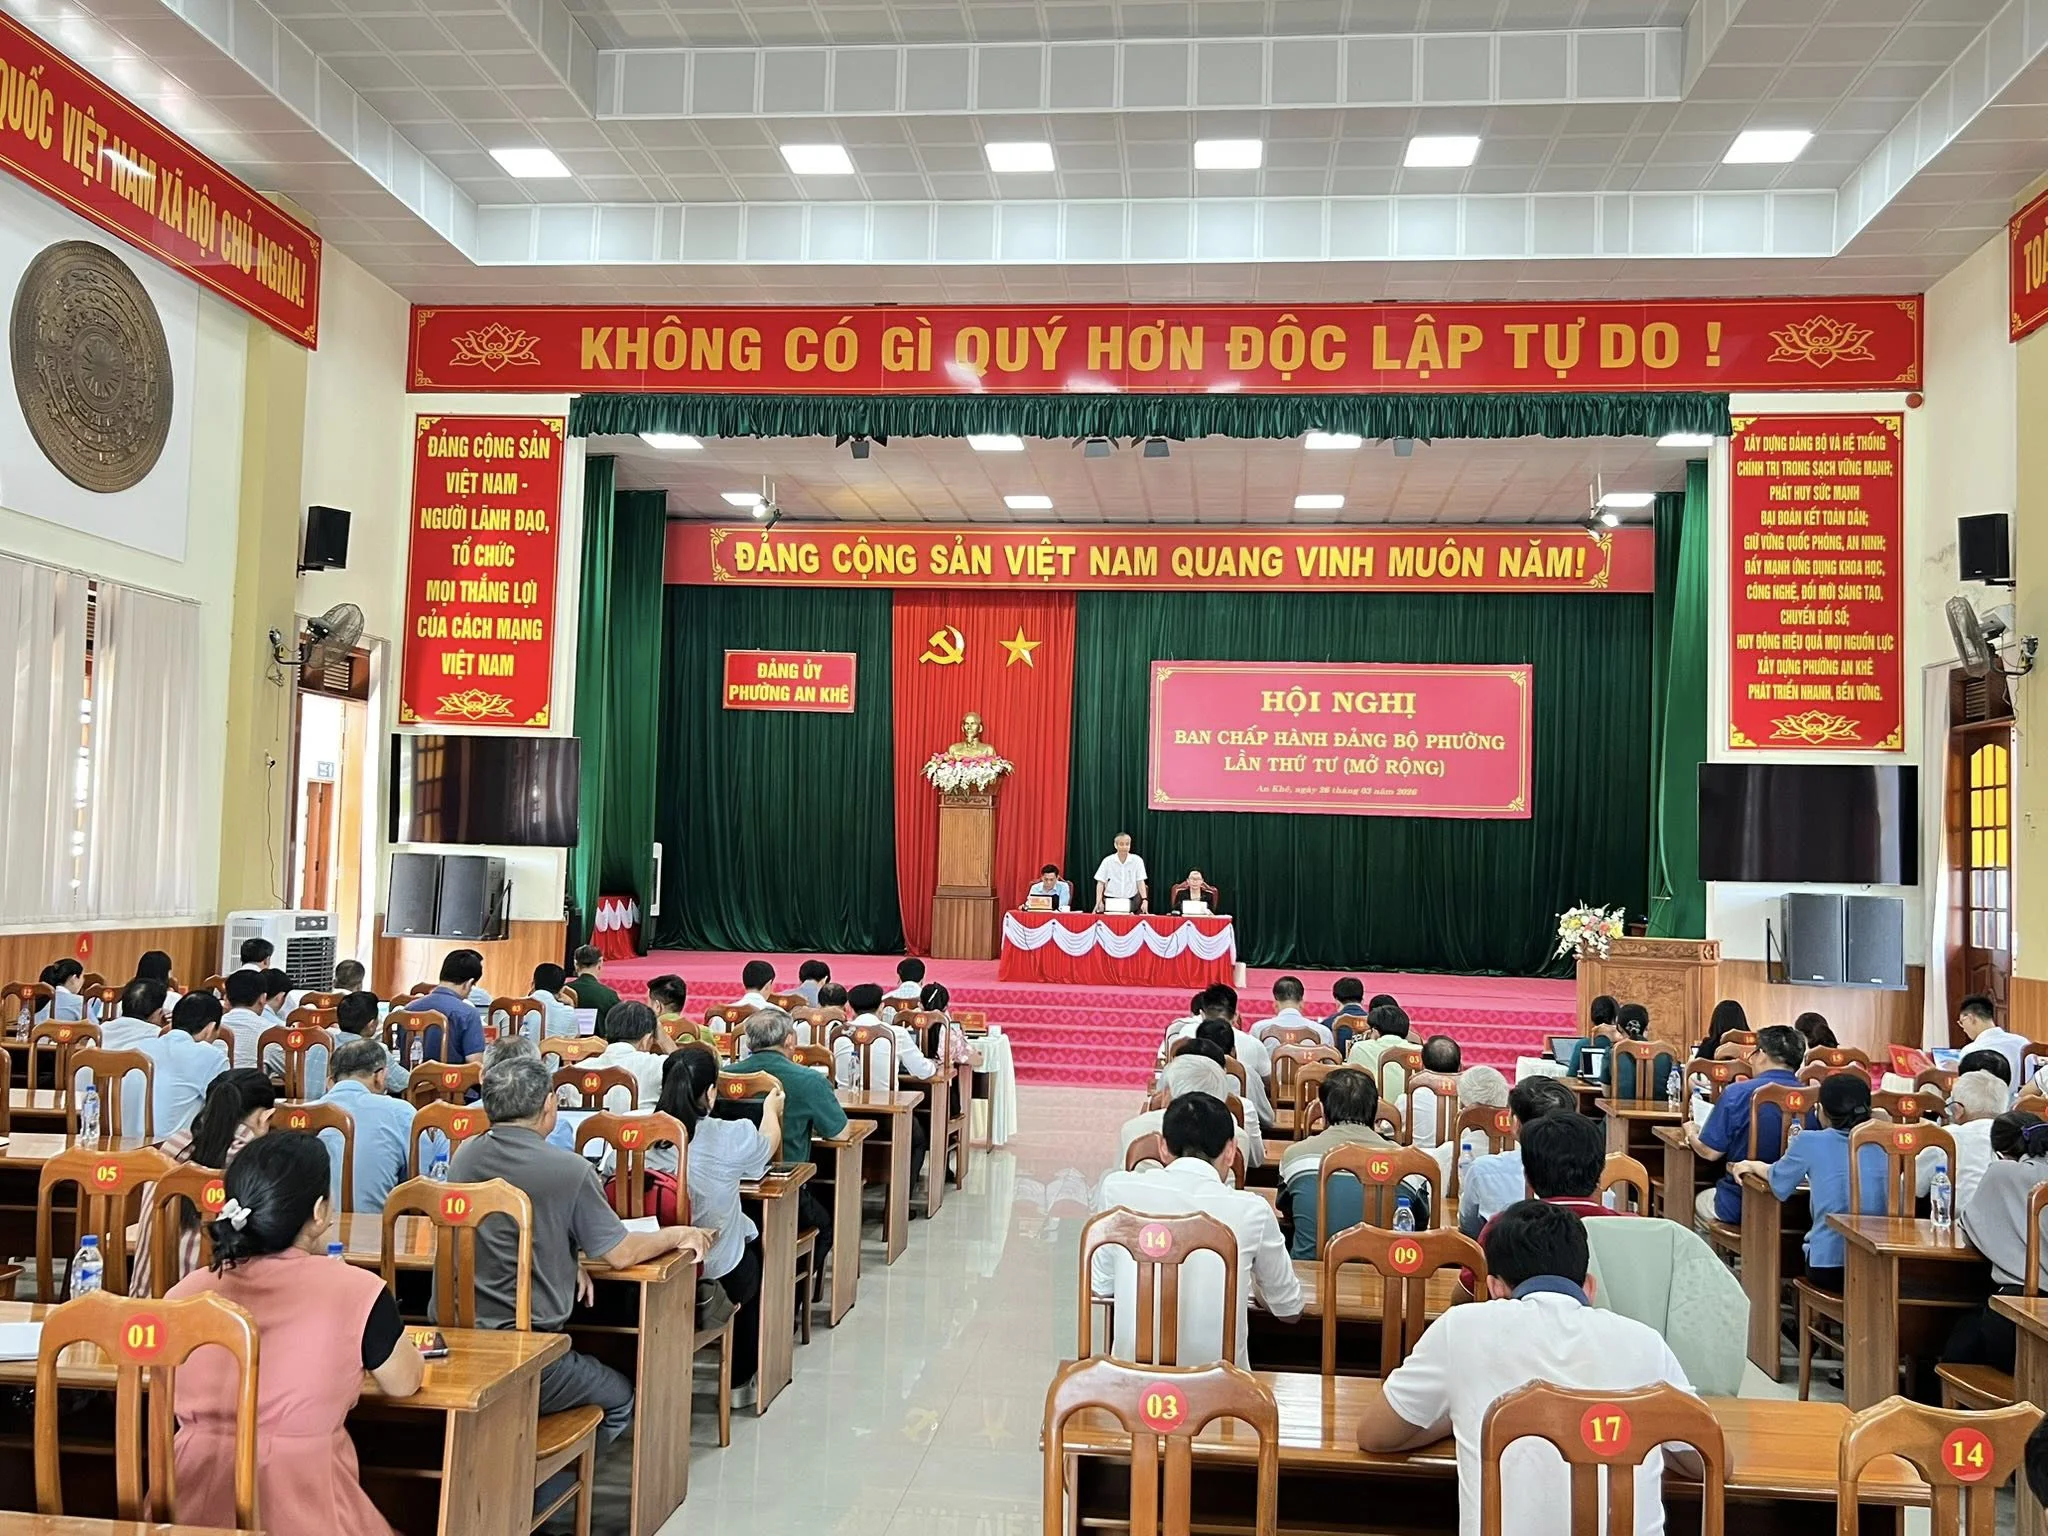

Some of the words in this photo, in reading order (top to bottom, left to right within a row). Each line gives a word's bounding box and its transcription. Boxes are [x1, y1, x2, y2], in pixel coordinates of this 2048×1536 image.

[62, 102, 107, 186] VIỆT
[111, 134, 156, 216] NAM
[159, 168, 183, 233] XÃ
[187, 184, 216, 258] HỘI
[221, 209, 252, 275] CHỦ
[256, 233, 305, 309] NGHĨA!
[581, 315, 761, 371] KHÔNG
[785, 316, 856, 372] CÓ
[882, 317, 931, 372] GÌ
[955, 315, 1066, 378] QUÝ
[1087, 318, 1206, 372] HƠN
[1223, 314, 1346, 384] ĐỘC
[1373, 314, 1483, 379] LẬP
[1504, 317, 1585, 378] TỰ
[1600, 322, 1679, 368] DO
[1707, 322, 1721, 366] !
[428, 428, 468, 457] ĐẢNG
[473, 432, 514, 462] CỘNG
[519, 430, 550, 459] SẢN
[447, 468, 478, 498] VIỆT
[482, 473, 517, 494] NAM
[421, 504, 467, 529] NGƯỜI
[471, 505, 510, 530] LÃNH
[515, 509, 549, 535] ĐẠO,
[452, 536, 472, 566] TỔ
[474, 541, 515, 567] CHỨC
[735, 533, 819, 573] ĐẢNG
[832, 536, 916, 579] CỘNG
[930, 535, 991, 574] SẢN
[1004, 537, 1075, 581] VIỆT
[1091, 546, 1157, 575] NAM
[1172, 546, 1283, 578] QUANG
[1296, 546, 1373, 576] VINH
[1389, 538, 1484, 577] MUÔN
[1499, 539, 1585, 577] NĂM!
[426, 580, 455, 606] MỌI
[460, 573, 509, 603] THẮNG
[514, 580, 537, 608] LỢI
[418, 608, 447, 638] CỦA
[452, 612, 492, 639] CÁCH
[497, 618, 542, 644] MẠNG
[442, 649, 475, 679] VIỆT
[478, 654, 514, 676] NAM
[758, 658, 799, 679] ĐẢNG
[729, 682, 790, 701] PHƯỜNG
[794, 686, 816, 702] AN
[820, 685, 849, 703] KHÊ
[1261, 686, 1320, 717] HỘI
[1332, 692, 1416, 719] NGHỊ
[1175, 730, 1211, 744] BAN
[1217, 725, 1268, 745] CHẤP
[1274, 728, 1328, 746] HÀNH
[1334, 728, 1387, 748] ĐẢNG
[1393, 730, 1418, 751] BỘ
[1426, 731, 1505, 750] PHƯỜNG
[1224, 749, 1261, 771] LẦN
[1268, 754, 1307, 772] THỨ
[1313, 756, 1338, 772] TƯ
[1344, 754, 1379, 775] (MỞ
[1385, 757, 1444, 777] RỘNG)
[79, 939, 89, 953] A
[290, 1034, 302, 1045] 14
[1408, 1054, 1421, 1064] 03
[1638, 1046, 1650, 1056] 14
[445, 1072, 458, 1084] 07
[584, 1076, 598, 1087] 04
[729, 1082, 743, 1094] 08
[1788, 1095, 1802, 1108] 14
[1901, 1099, 1915, 1112] 15
[290, 1115, 306, 1129] 04
[453, 1117, 471, 1132] 07
[622, 1129, 640, 1144] 07
[1897, 1133, 1913, 1147] 18
[96, 1165, 117, 1182] 05
[1371, 1161, 1390, 1175] 05
[205, 1188, 225, 1204] 09
[444, 1197, 467, 1215] 10
[1144, 1231, 1167, 1249] 14
[1394, 1248, 1418, 1265] 09
[127, 1324, 156, 1348] 01
[1146, 1393, 1180, 1420] 03
[1590, 1416, 1622, 1443] 17
[1951, 1442, 1984, 1467] 14
